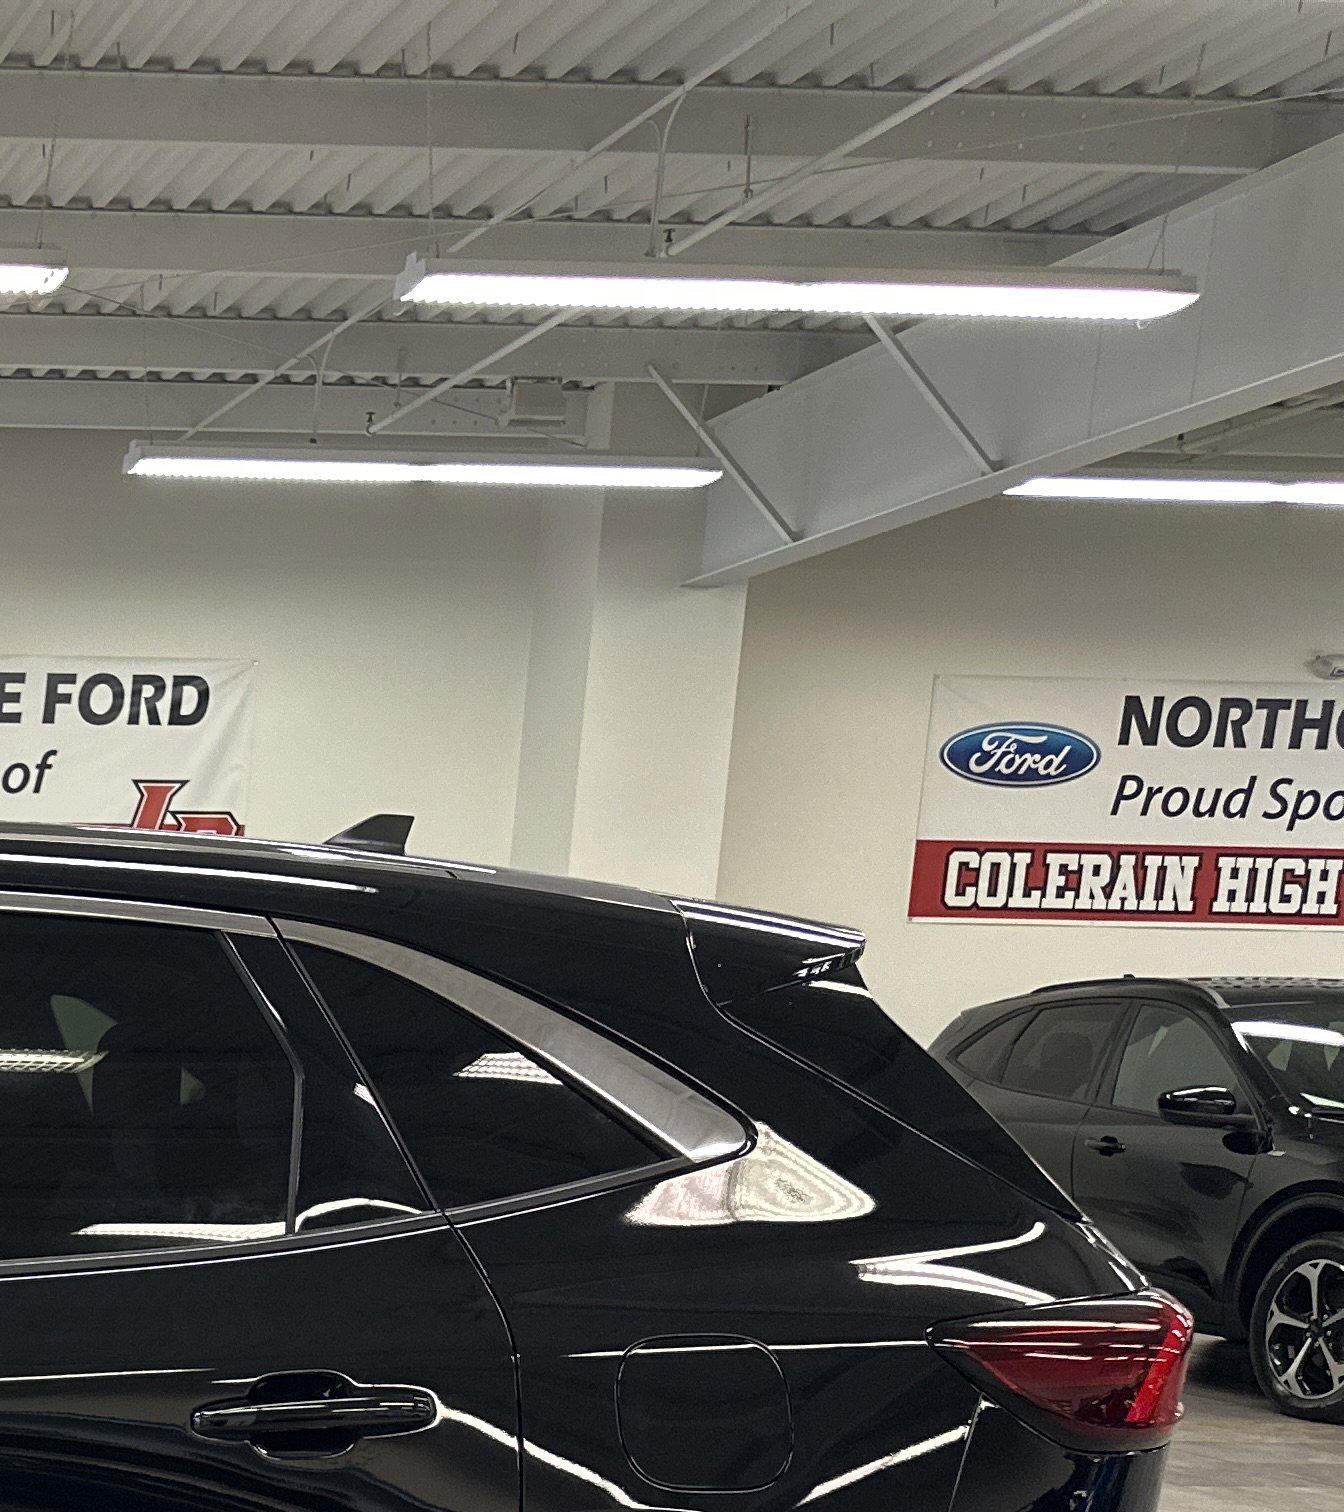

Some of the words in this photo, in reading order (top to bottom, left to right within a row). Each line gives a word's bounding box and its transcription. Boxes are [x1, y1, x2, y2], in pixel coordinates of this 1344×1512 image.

[41, 672, 210, 726] FORD
[1117, 694, 1344, 750] NORTH
[1, 749, 58, 794] of
[968, 731, 1072, 777] Ford
[1110, 774, 1258, 819] Proud
[1262, 777, 1344, 832] Spo
[942, 850, 1201, 914] COLERAIN
[1211, 855, 1344, 916] HIGH
